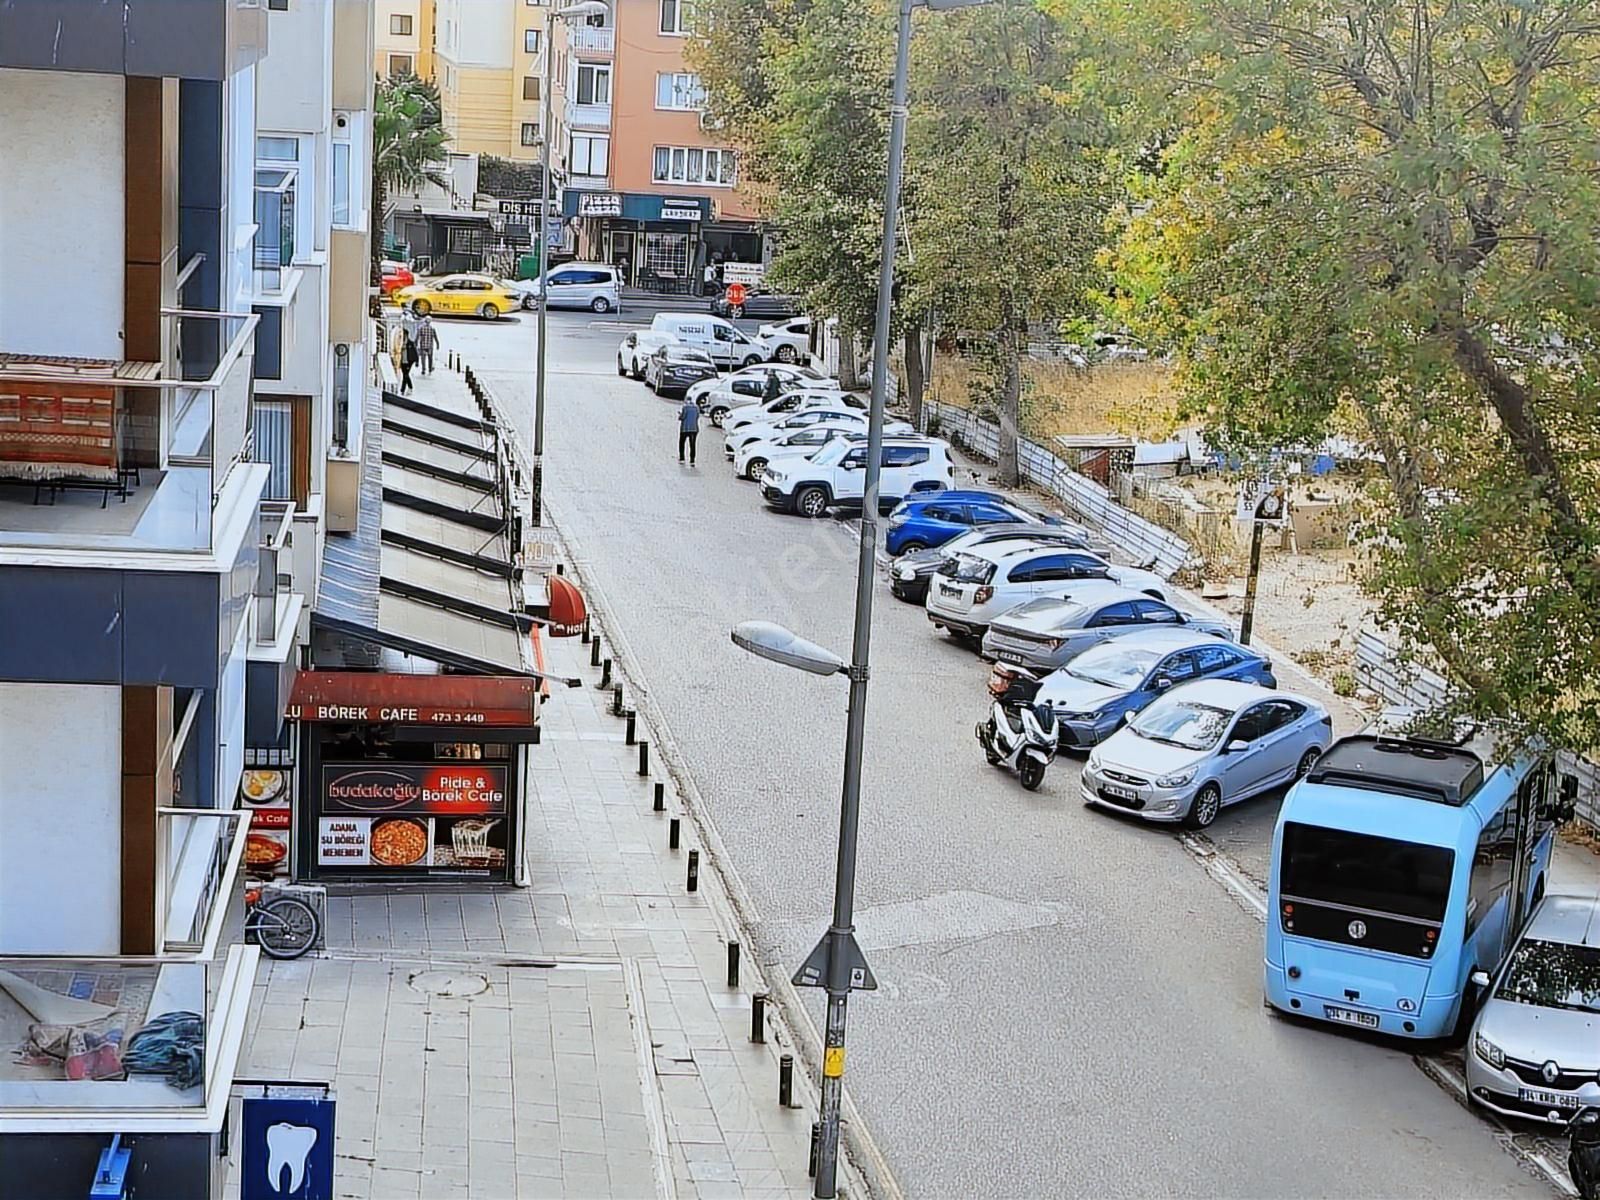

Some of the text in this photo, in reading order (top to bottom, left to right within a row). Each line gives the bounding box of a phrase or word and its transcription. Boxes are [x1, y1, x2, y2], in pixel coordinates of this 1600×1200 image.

[318, 704, 368, 719] BÖREK
[380, 708, 418, 721] CAFE
[440, 776, 486, 789] Pide &
[422, 787, 503, 801] Börek Cafe
